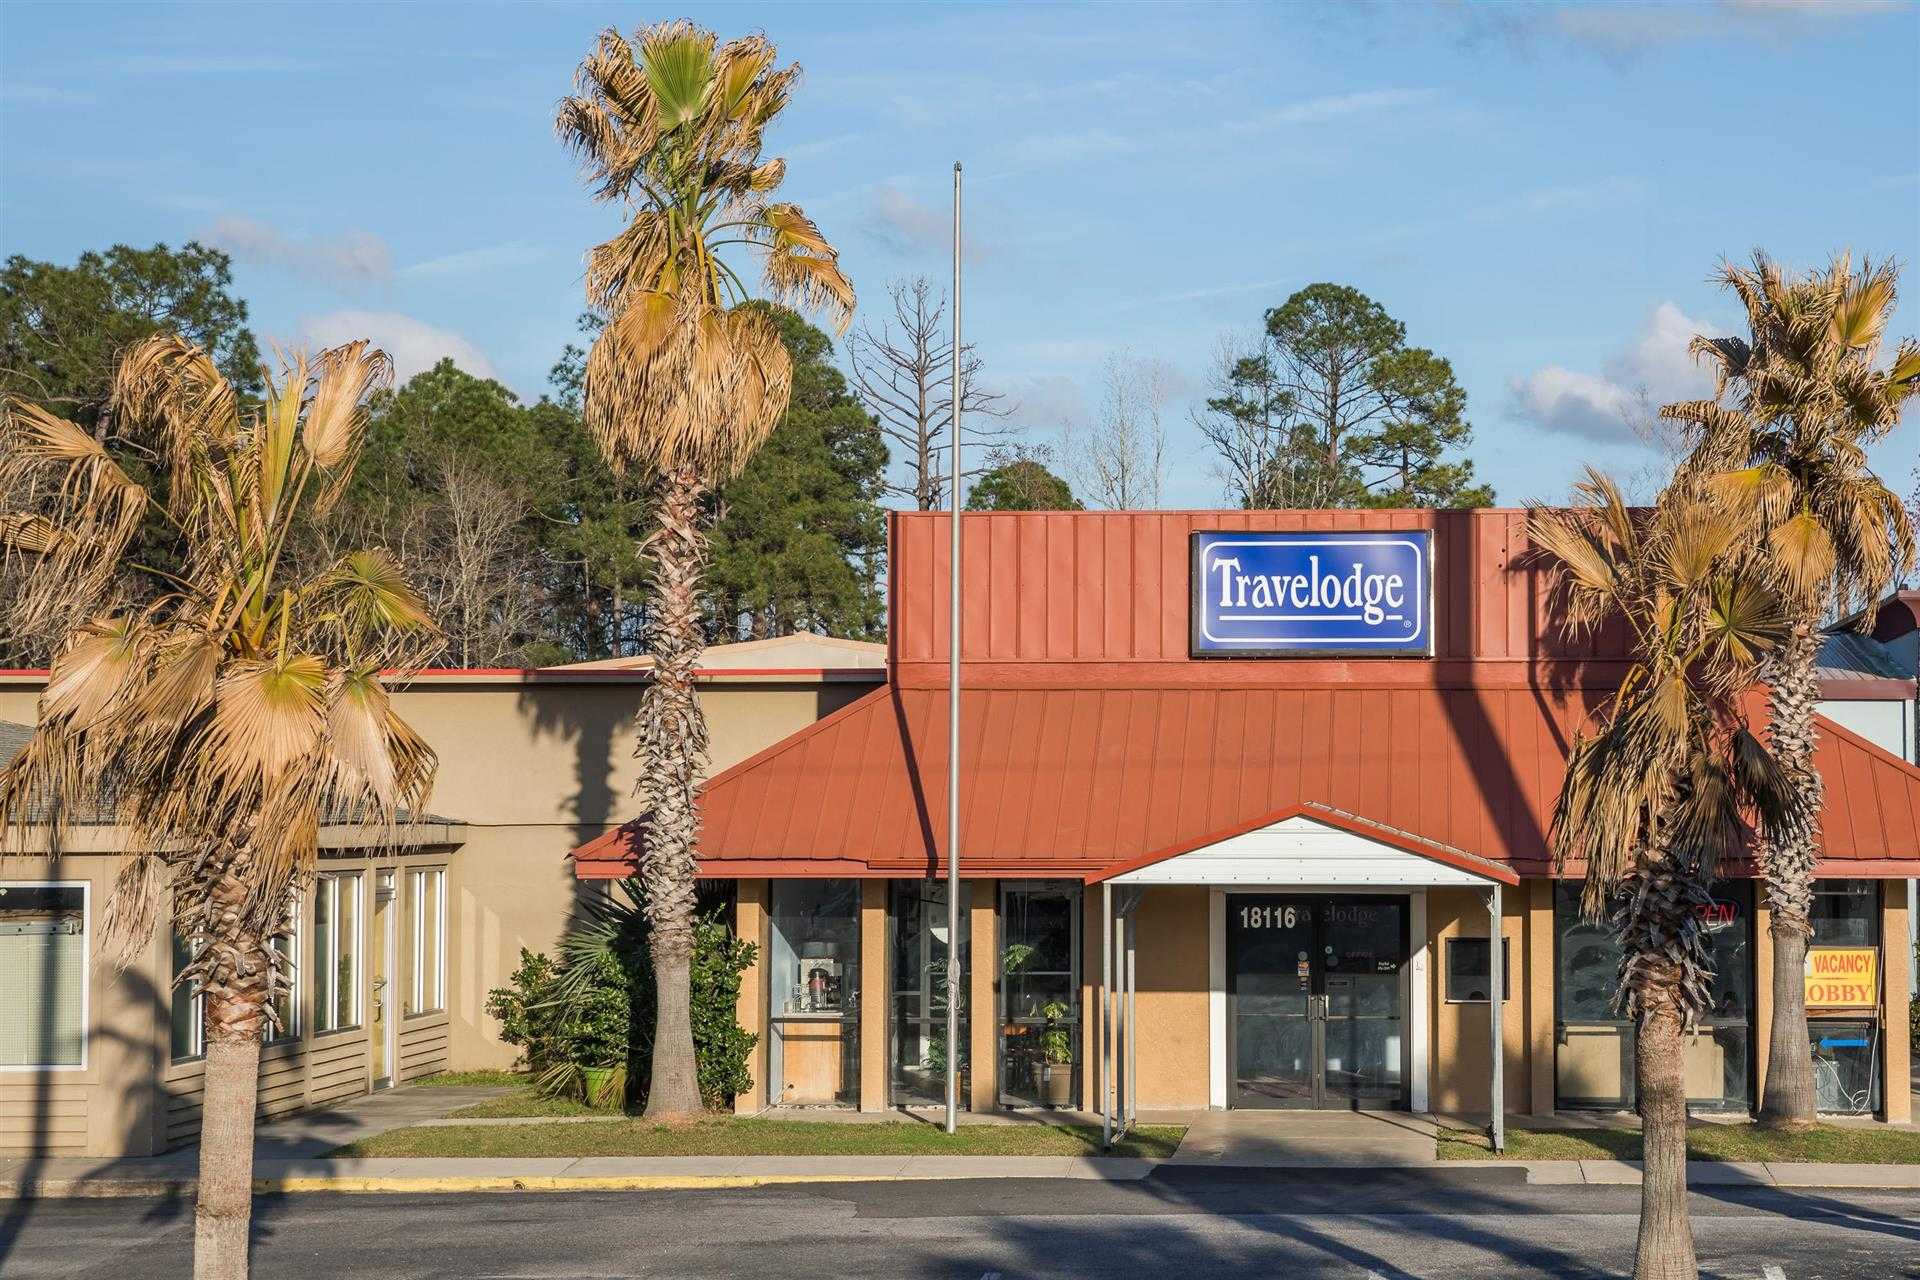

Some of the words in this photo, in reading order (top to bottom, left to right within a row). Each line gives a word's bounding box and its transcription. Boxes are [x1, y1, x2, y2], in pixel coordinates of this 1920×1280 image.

[1212, 555, 1404, 625] Travelodge
[1240, 907, 1296, 928] 18116
[1814, 955, 1871, 973] VACANCY
[1806, 984, 1872, 1001] OBBY
